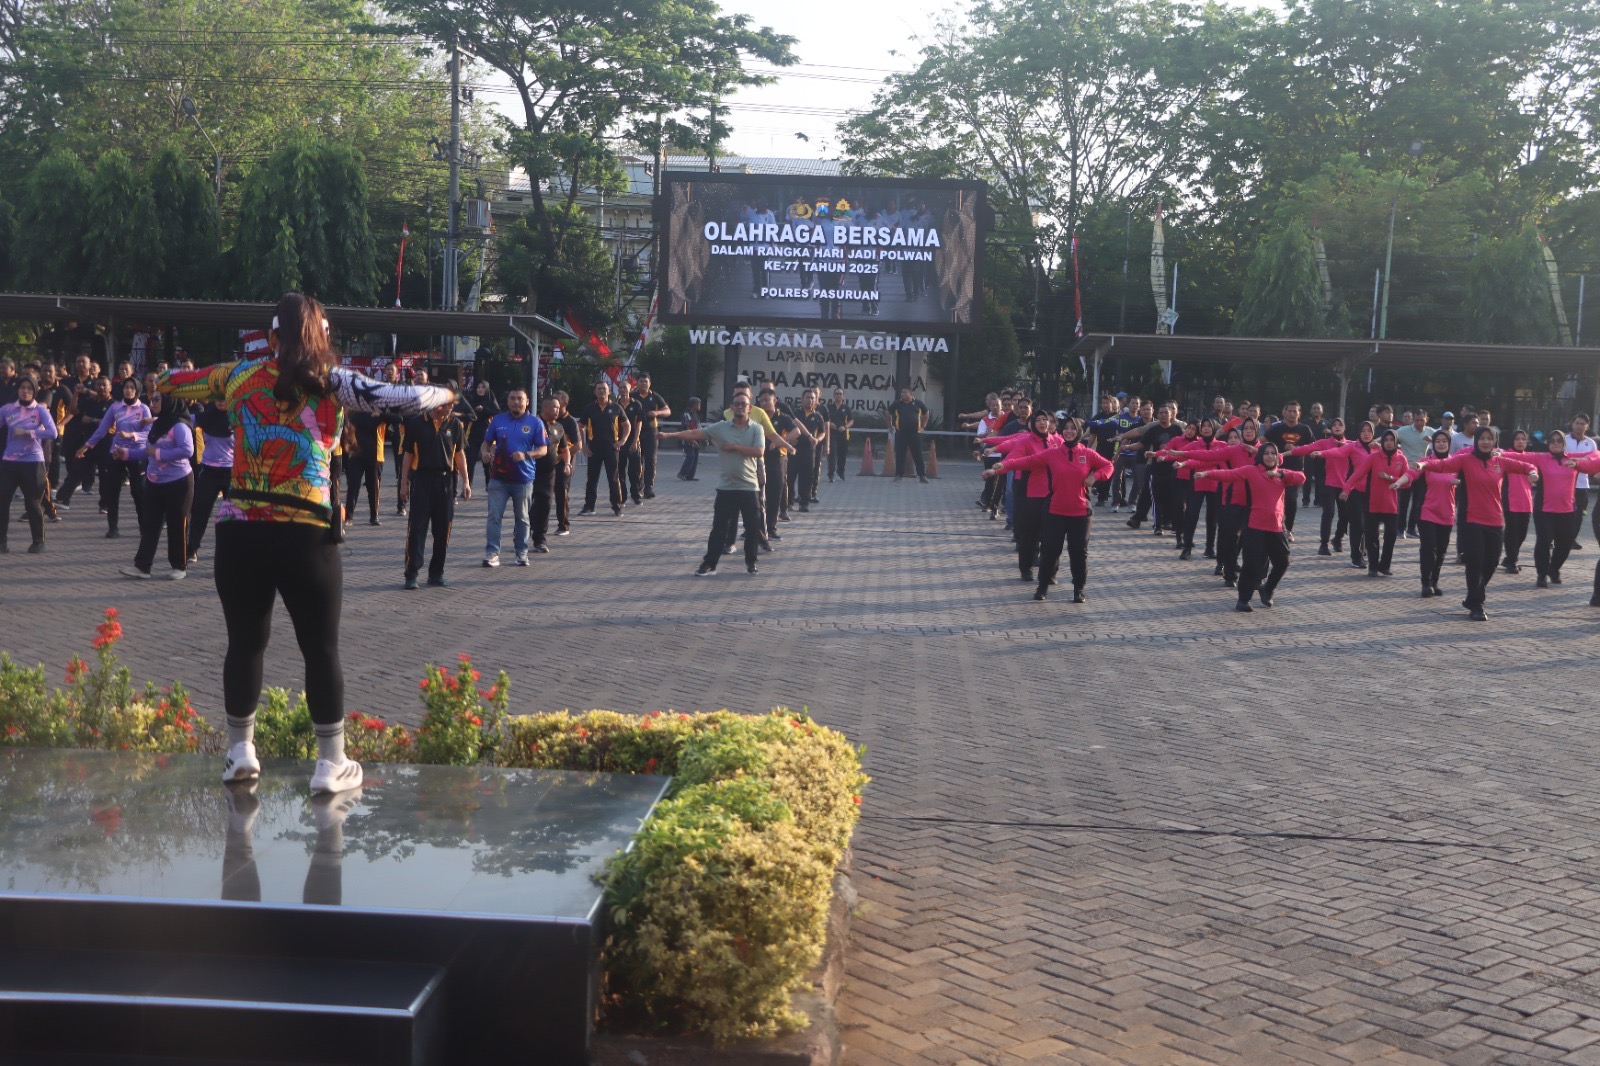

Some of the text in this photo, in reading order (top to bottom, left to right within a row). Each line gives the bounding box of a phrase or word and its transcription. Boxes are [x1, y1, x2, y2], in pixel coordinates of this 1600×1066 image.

[704, 222, 940, 247] OLAHRAGA BERSAMA
[711, 245, 933, 261] DALAM RANGKA HARI JADI POLWAN
[764, 261, 879, 274] KE-77 TAHUN 2025
[761, 287, 879, 300] POLRES PASURUAN
[689, 329, 949, 353] WICAKSANA LAGHAWA
[767, 351, 888, 365] LAPANGAN APEL
[843, 373, 926, 392] RACAA
